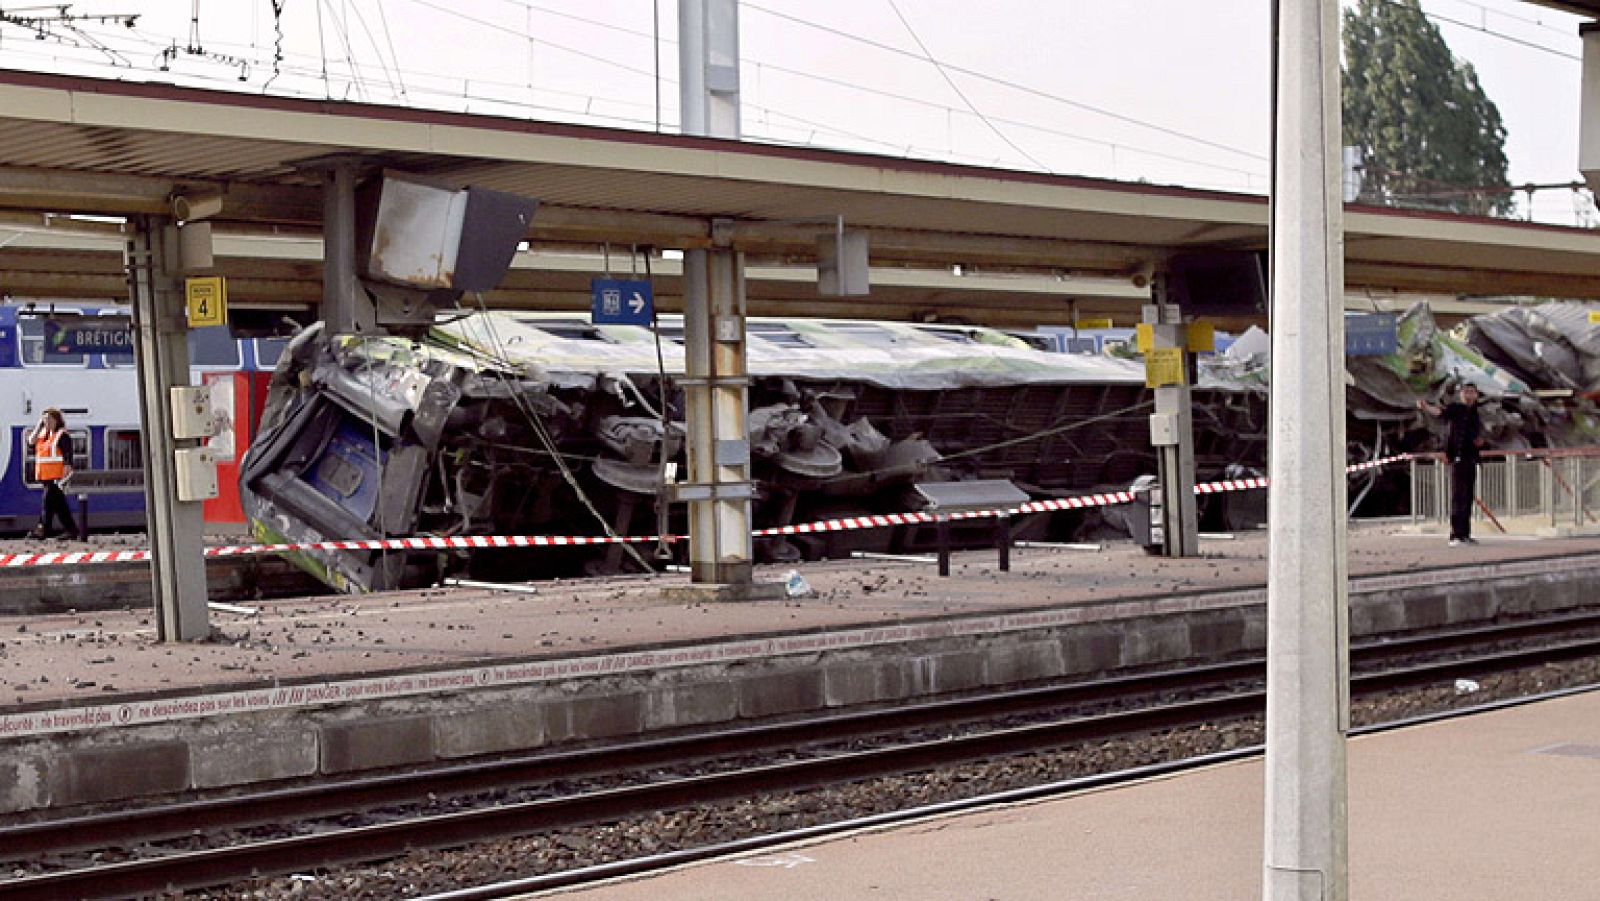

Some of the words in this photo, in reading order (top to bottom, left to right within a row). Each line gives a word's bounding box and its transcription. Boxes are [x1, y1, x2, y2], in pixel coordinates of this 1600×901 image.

[197, 296, 207, 314] 4
[139, 707, 150, 717] ne
[151, 700, 198, 716] descendez
[199, 699, 215, 714] pas
